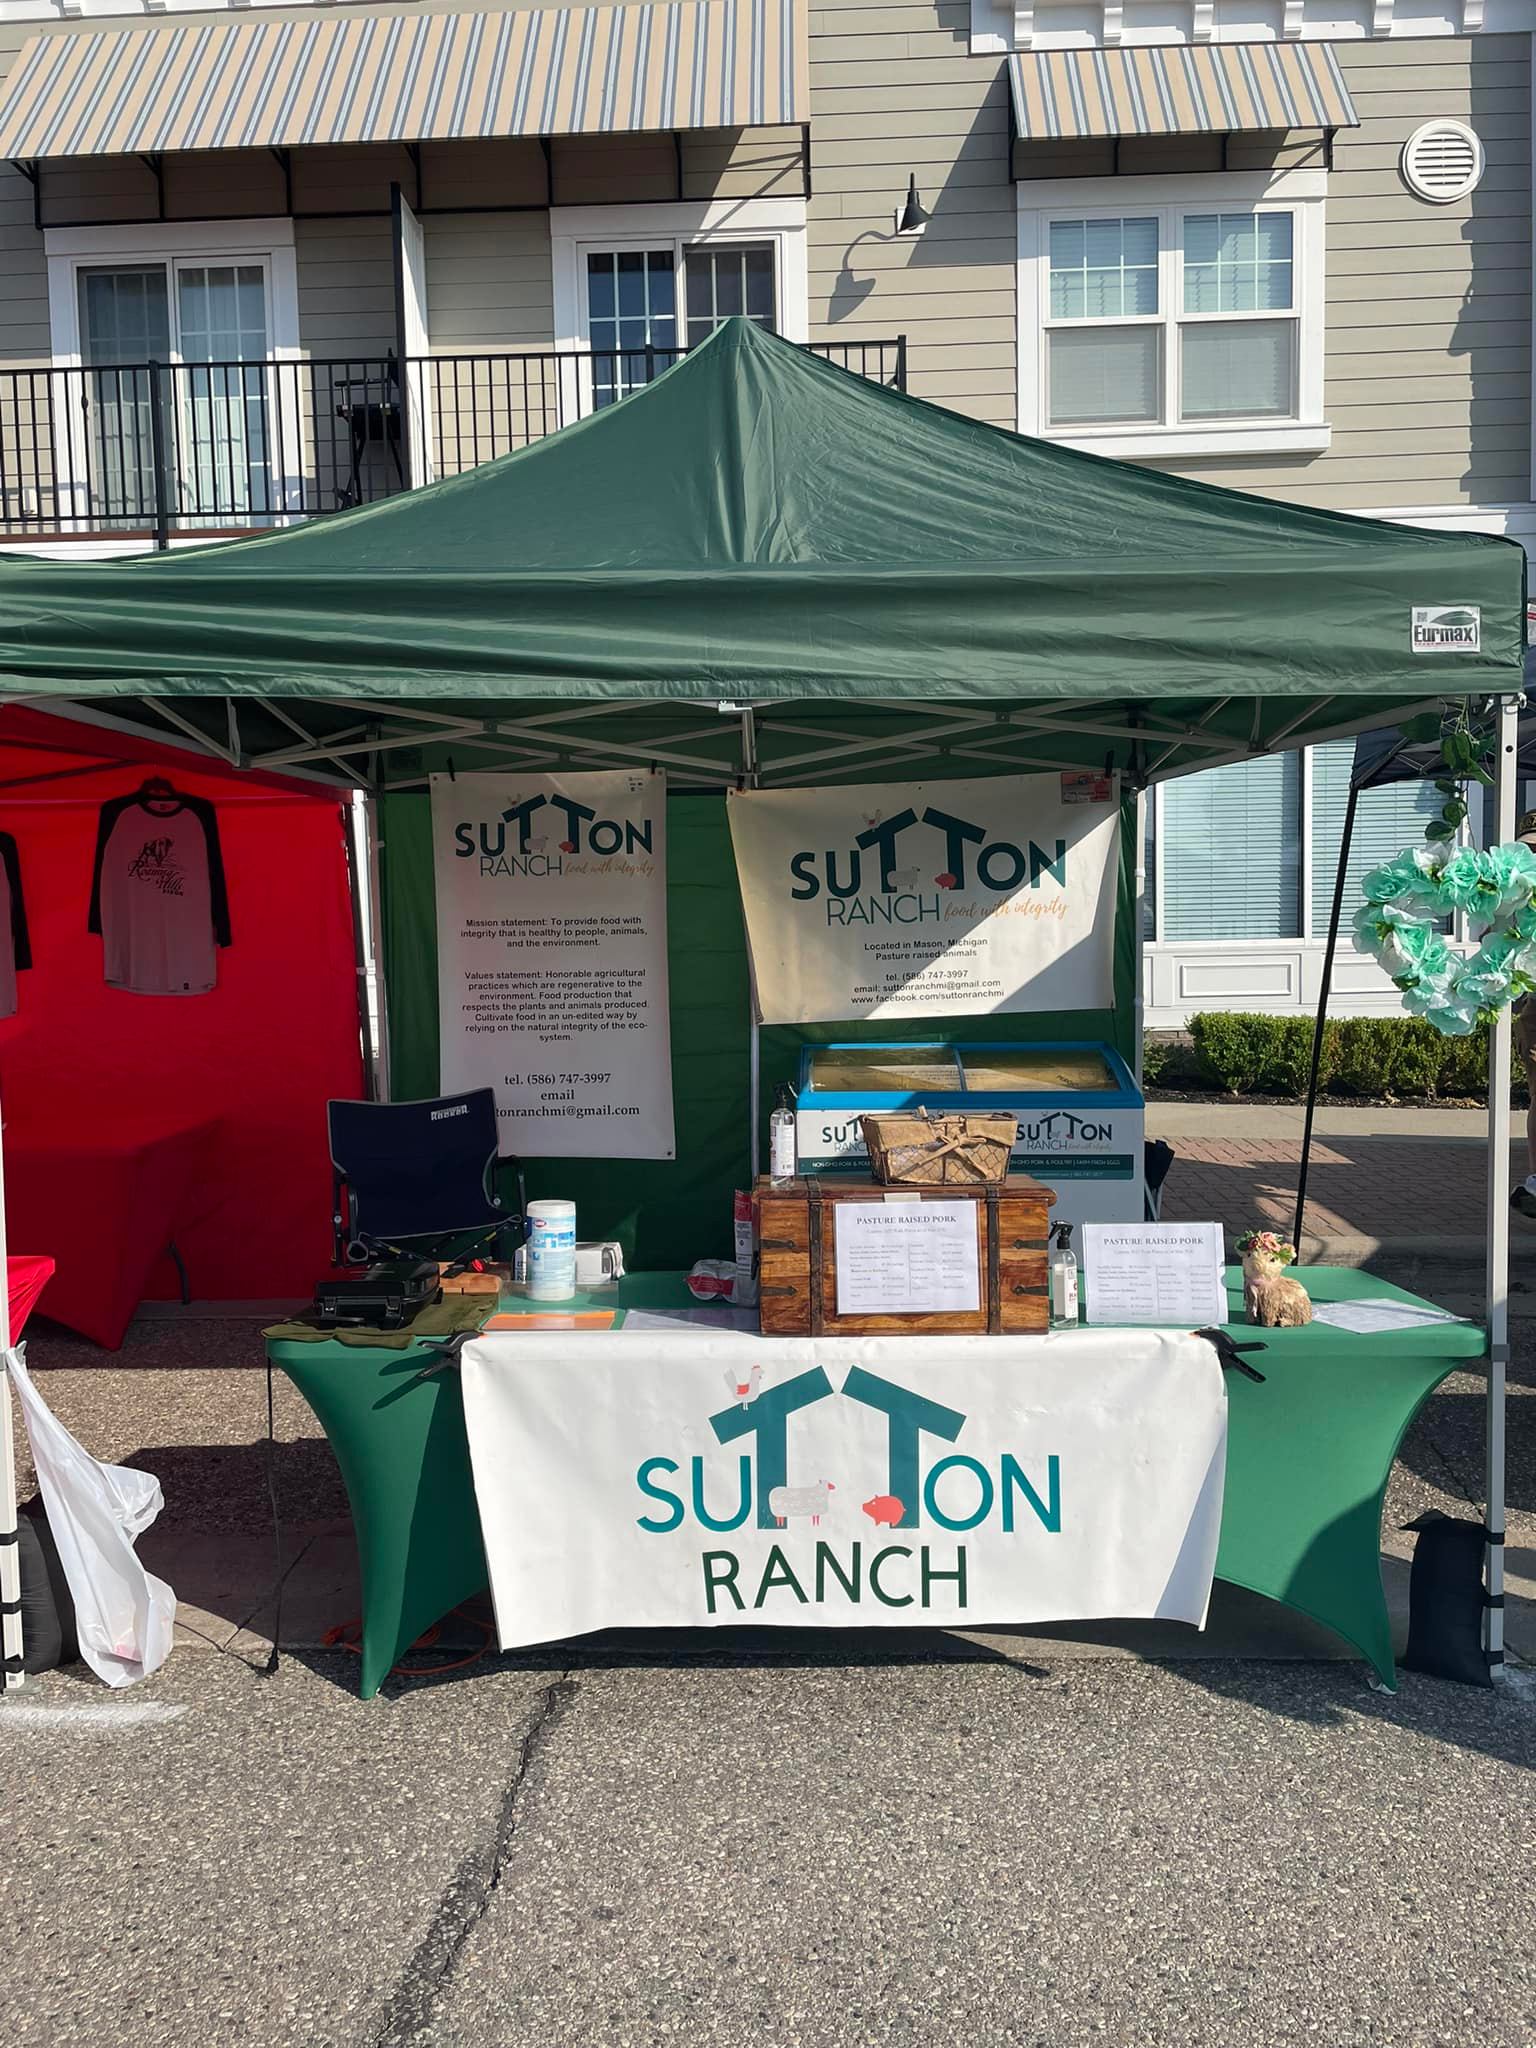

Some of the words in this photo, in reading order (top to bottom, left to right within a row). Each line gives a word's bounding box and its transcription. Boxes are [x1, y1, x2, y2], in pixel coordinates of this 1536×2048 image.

[1414, 625, 1473, 642] Eurmax
[455, 793, 652, 857] SUTTON
[791, 807, 1066, 900] SUTTON
[480, 855, 562, 876] RANCH
[565, 861, 589, 874] food
[827, 894, 940, 926] RANCH
[944, 902, 977, 921] food
[980, 897, 1010, 917] with
[1014, 896, 1068, 918] integrity
[564, 917, 597, 926] provide
[600, 917, 620, 925] food
[461, 928, 497, 938] integrity
[499, 928, 516, 937] that
[519, 928, 526, 936] is
[529, 928, 561, 937] healthy
[564, 928, 572, 936] to
[575, 928, 608, 937] people,
[611, 927, 647, 936] animals,
[507, 939, 523, 948] and
[527, 939, 540, 947] the
[865, 942, 900, 950] Located
[914, 940, 945, 948] Mason,
[948, 939, 987, 948] Michigan
[876, 952, 910, 960] Pasture
[913, 950, 940, 958] raised
[943, 949, 977, 957] animals
[546, 970, 591, 978] Honorable
[595, 969, 645, 978] agricultural
[902, 973, 925, 981] (586)
[928, 970, 968, 979] 747-3997
[468, 982, 509, 991] practices
[512, 981, 537, 989] which
[557, 980, 613, 990] regenerative
[564, 991, 612, 1001] production
[615, 990, 632, 998] that
[462, 1003, 500, 1012] respects
[503, 1002, 516, 1010] the
[519, 1002, 546, 1012] plants
[550, 1002, 565, 1010] and
[568, 1001, 601, 1009] animals
[475, 1013, 513, 1022] Cultivate
[516, 1013, 535, 1021] food
[562, 1012, 603, 1020] un-edited
[606, 1013, 624, 1022] way
[626, 1012, 637, 1021] by
[465, 1024, 495, 1034] relying
[527, 1023, 558, 1031] natural
[561, 1022, 598, 1032] integrity
[600, 1022, 609, 1030] of
[539, 1033, 573, 1042] system.
[505, 1075, 523, 1085] tel.
[528, 1074, 555, 1084] (586)
[560, 1073, 611, 1083] 747-3997
[540, 1089, 574, 1100] email
[496, 1105, 640, 1118] tonranchmi@gmail.com
[822, 1115, 863, 1143] SUT
[835, 1142, 866, 1152] RANC
[1027, 1140, 1067, 1150] RANCH
[857, 1216, 896, 1224] PASTURE
[899, 1216, 930, 1224] RAISED
[932, 1215, 956, 1223] PORK
[636, 1364, 1061, 1534] SUTTON
[702, 1541, 968, 1614] RANCH
